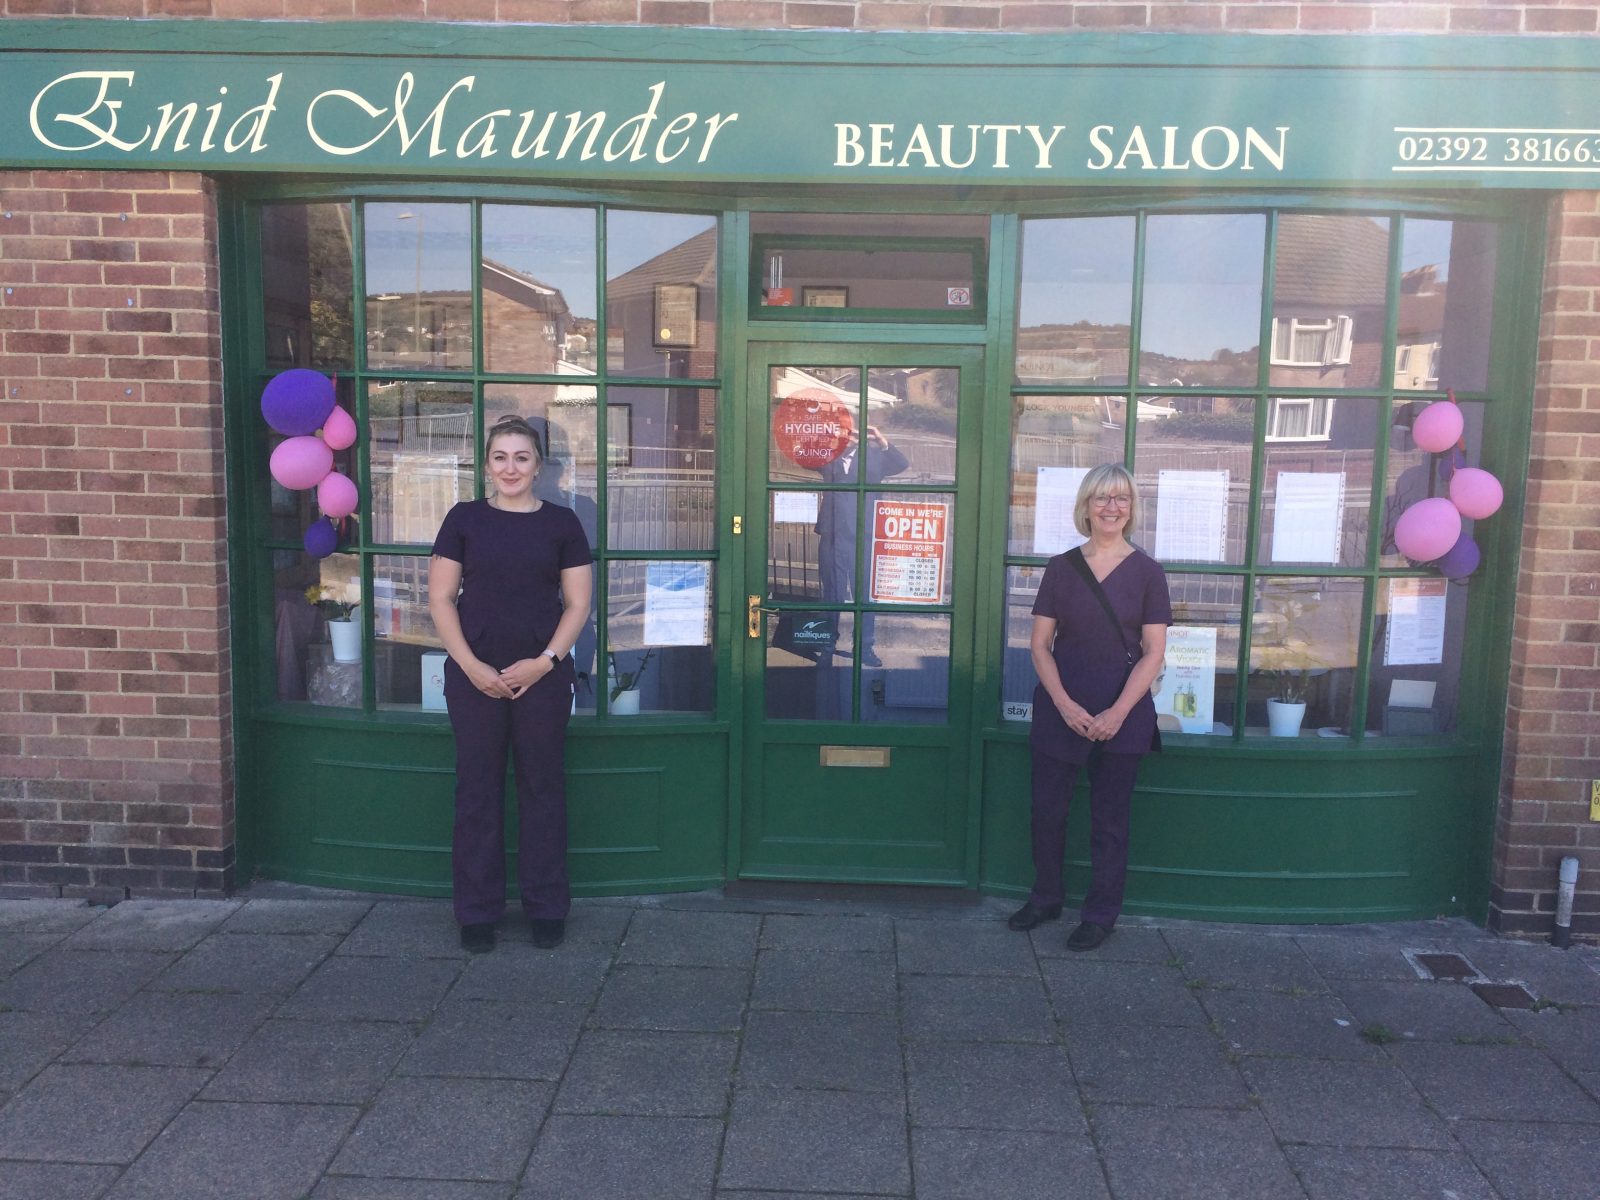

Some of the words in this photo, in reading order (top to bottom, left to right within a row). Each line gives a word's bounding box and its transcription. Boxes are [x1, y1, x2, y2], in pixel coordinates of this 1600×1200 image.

[29, 70, 284, 154] Enid
[306, 71, 739, 164] Maunder
[833, 122, 1068, 170] BEAUTY
[1086, 125, 1291, 172] SALON
[1398, 136, 1488, 161] 02392
[785, 423, 841, 434] HYGIENE
[793, 445, 833, 457] GUINOT
[878, 506, 904, 516] COME
[905, 508, 915, 517] IN
[917, 509, 944, 518] WE'RE
[884, 516, 938, 540] OPEN
[884, 543, 912, 551] BUSINESS
[1007, 705, 1028, 718] stay
